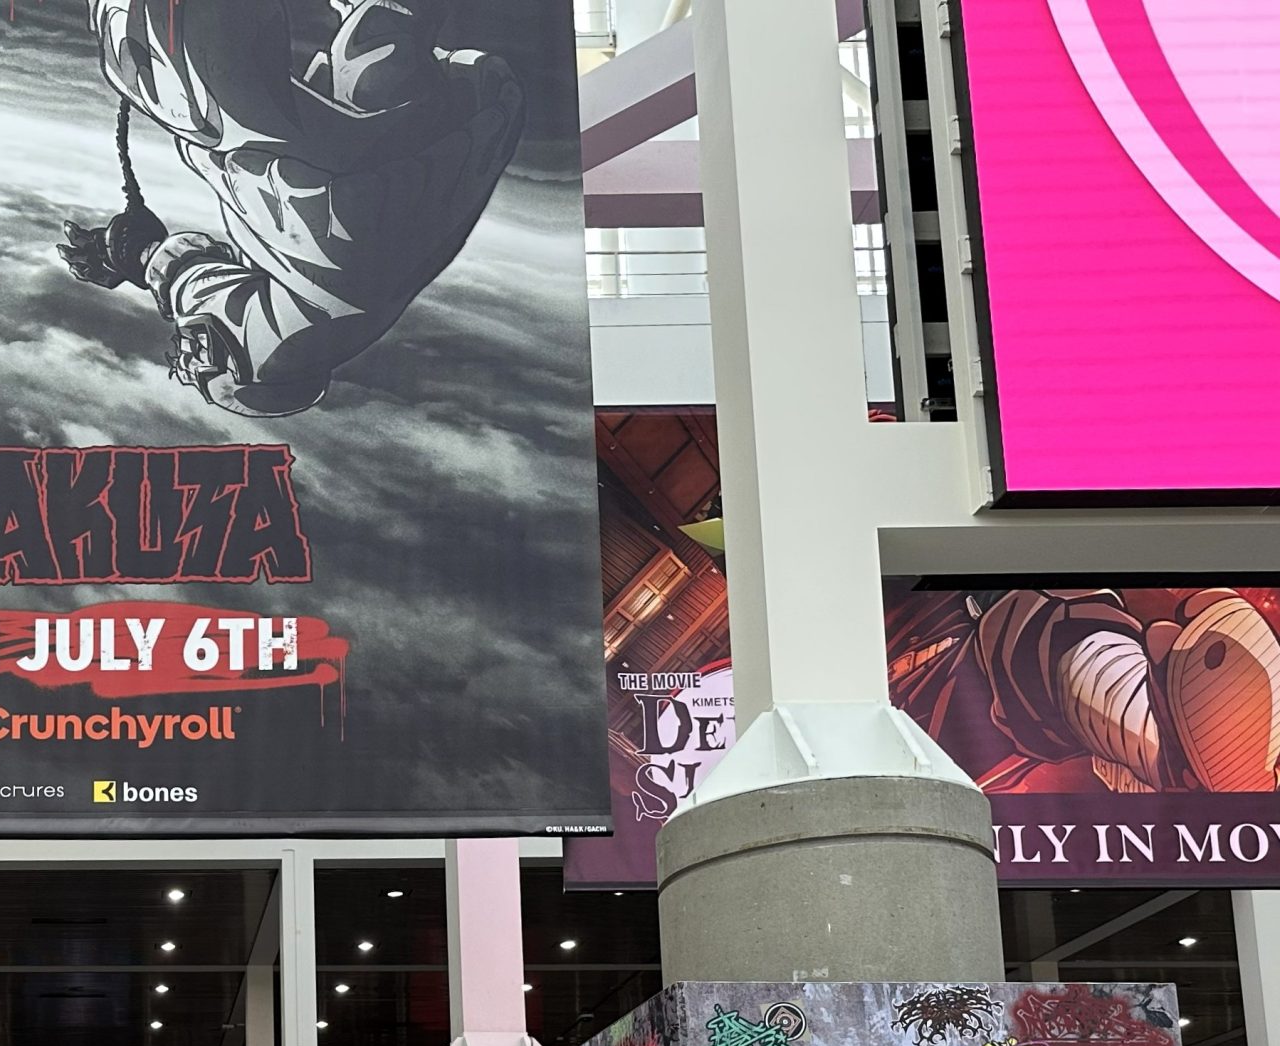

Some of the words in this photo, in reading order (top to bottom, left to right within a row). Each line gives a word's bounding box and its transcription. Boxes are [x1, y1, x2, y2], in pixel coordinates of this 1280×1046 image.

[17, 617, 163, 672] JULY
[182, 617, 299, 671] 6TH
[618, 673, 648, 690] THE
[652, 672, 702, 690] MOVIE
[634, 694, 735, 756] DE
[123, 781, 198, 802] bones
[1092, 824, 1156, 863] IN
[1173, 823, 1280, 863] MO
